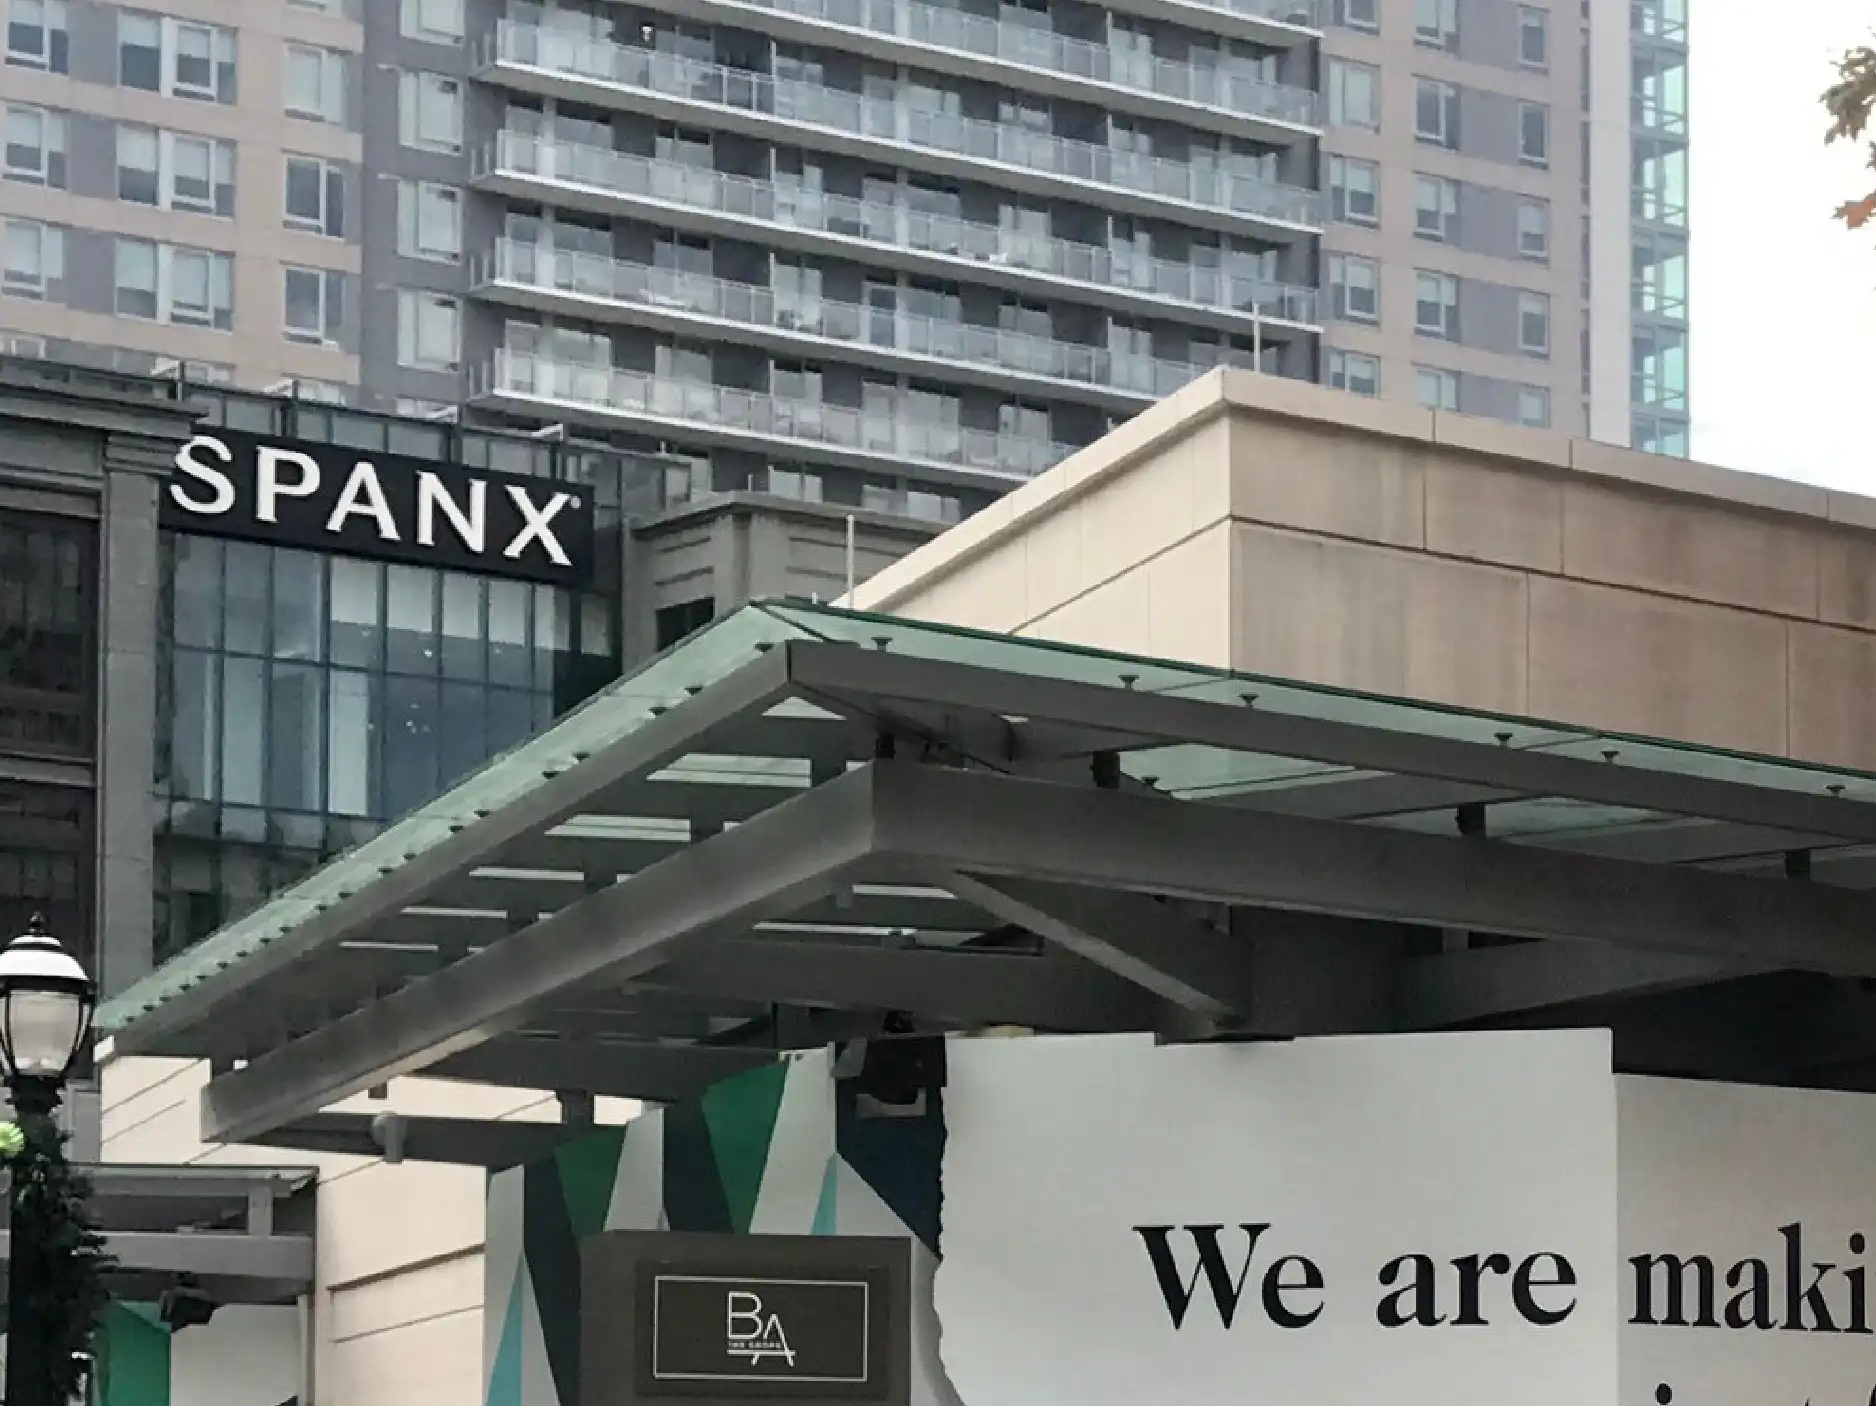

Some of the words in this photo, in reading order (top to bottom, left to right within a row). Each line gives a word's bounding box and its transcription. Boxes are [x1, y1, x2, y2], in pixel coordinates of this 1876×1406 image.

[170, 434, 574, 568] SPANX
[1131, 1222, 1326, 1333] We
[1376, 1250, 1578, 1330] are
